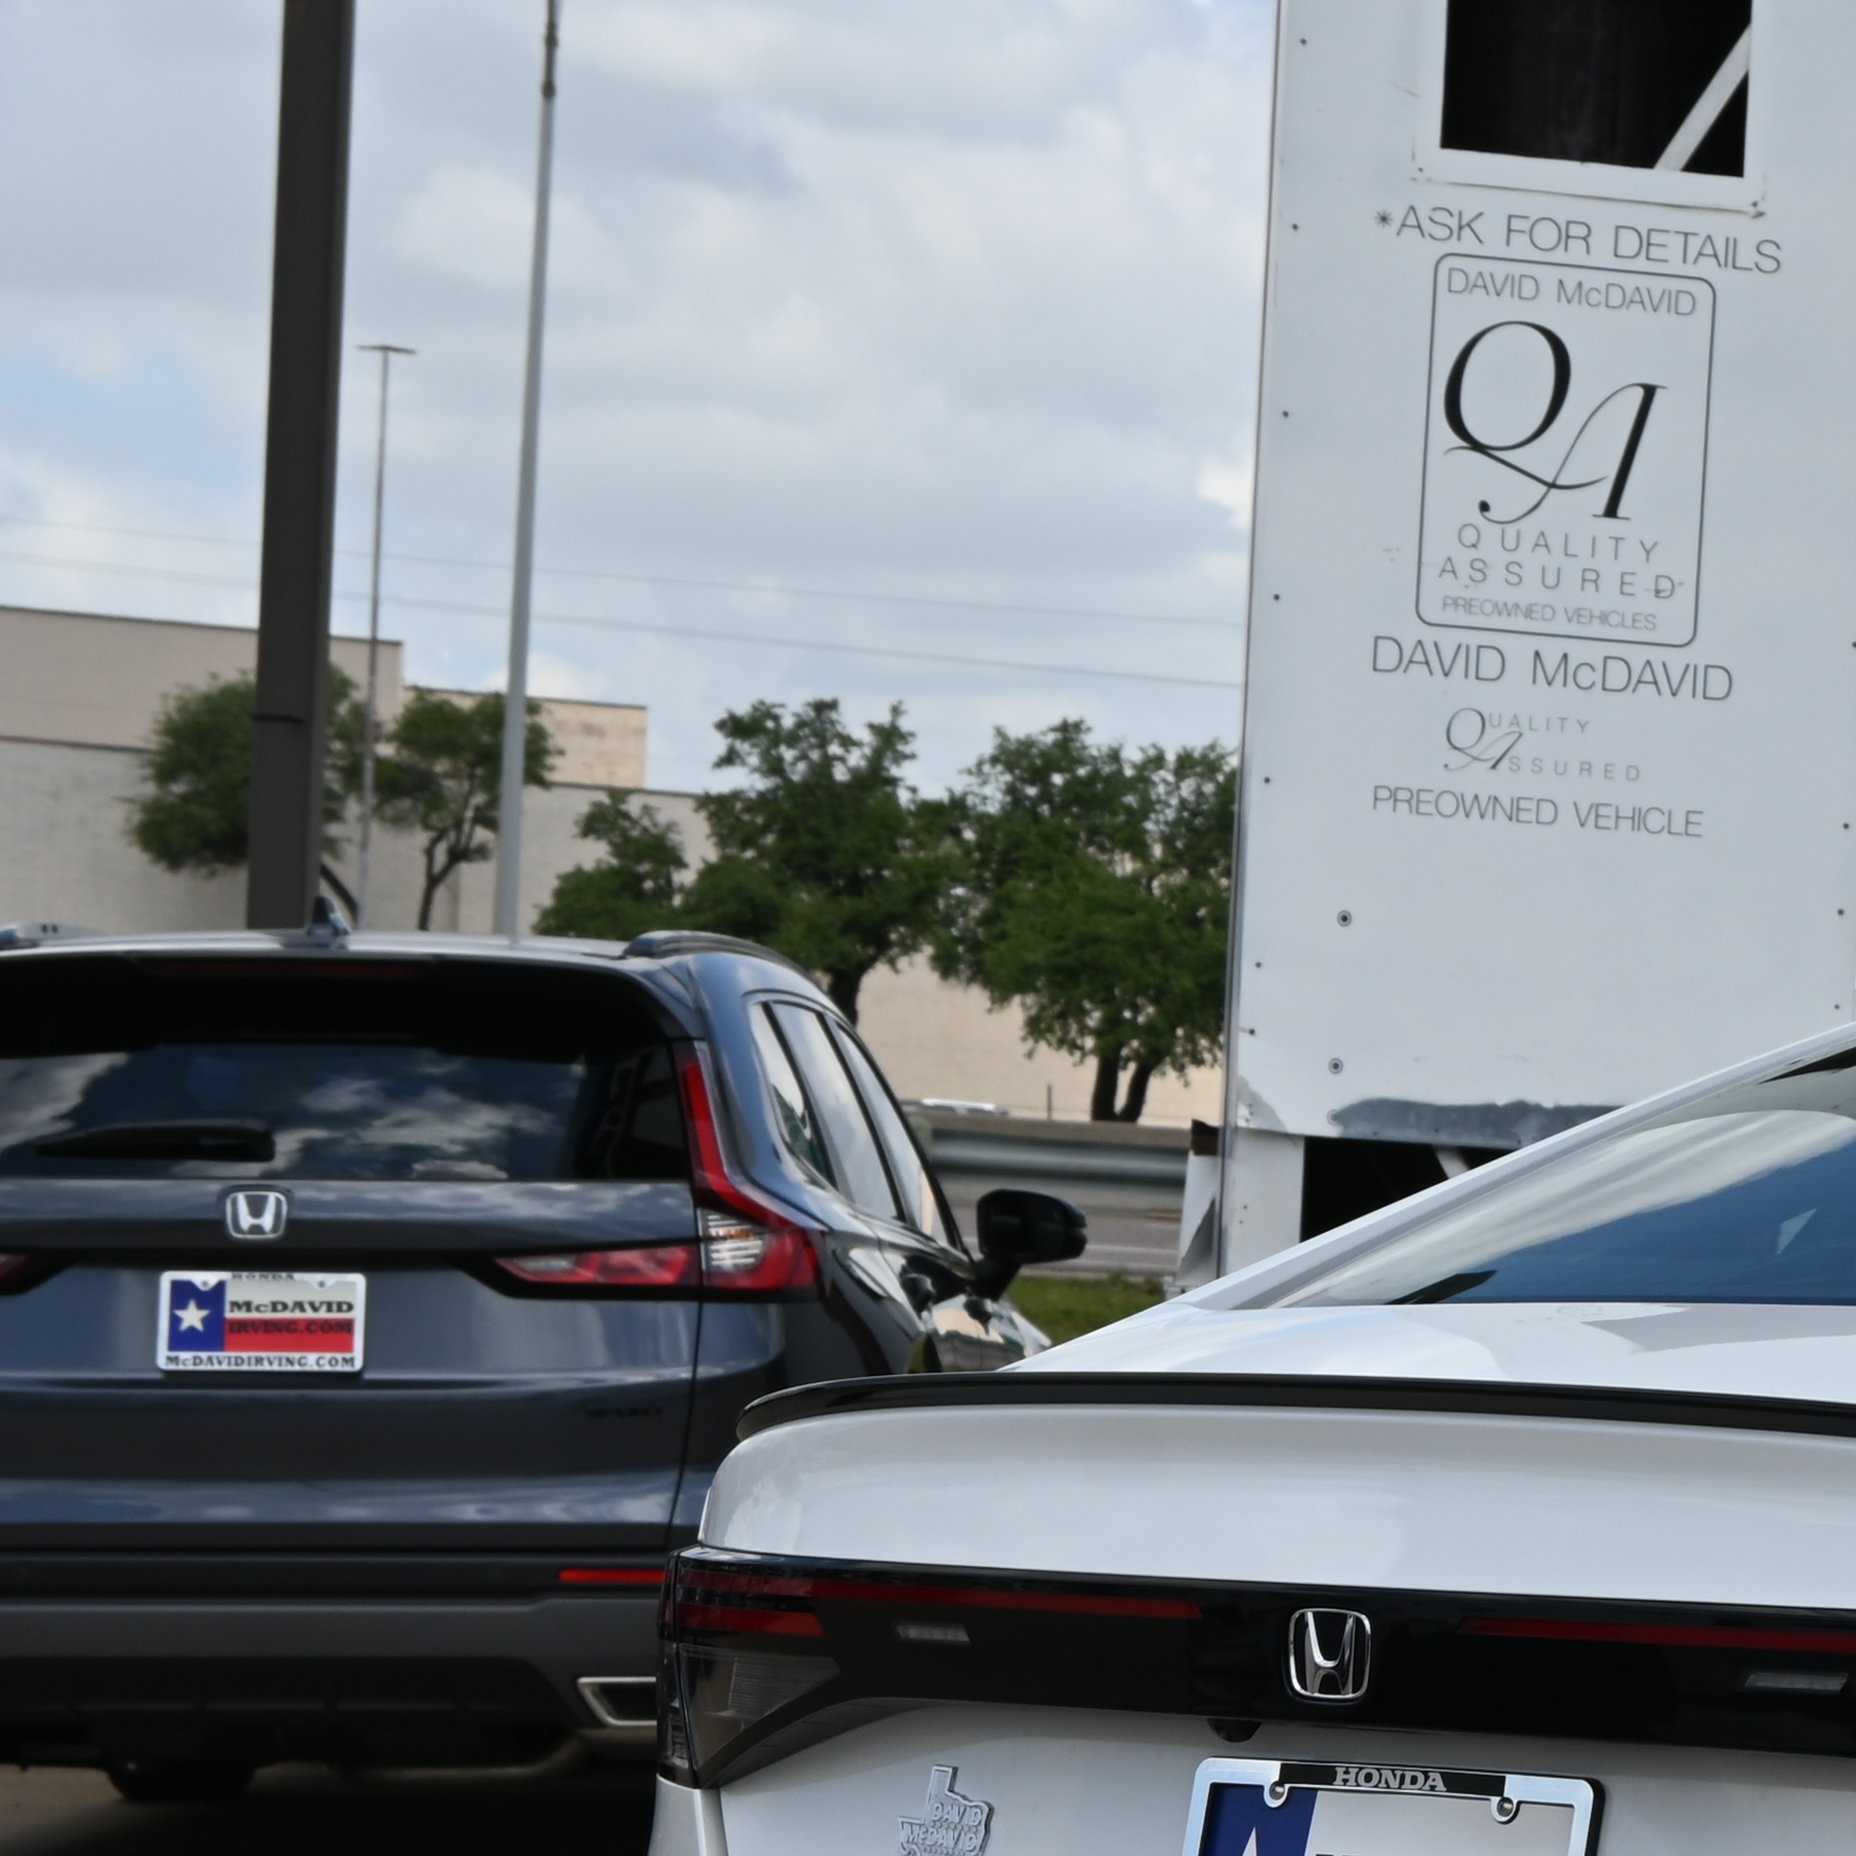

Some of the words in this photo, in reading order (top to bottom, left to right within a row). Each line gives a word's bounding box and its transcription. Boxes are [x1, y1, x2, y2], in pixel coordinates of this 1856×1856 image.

[1505, 214, 1592, 254] FOR
[1614, 226, 1782, 274] DETAILS
[1447, 268, 1540, 301] DAVID
[1557, 279, 1697, 316] McDAVID
[1457, 523, 1658, 563] QUALITY
[1439, 556, 1676, 599] ASSURED
[1442, 595, 1556, 622] PREOWNED
[1564, 606, 1658, 631] VEHICLES
[1372, 635, 1506, 682] DAVID
[1532, 649, 1733, 701] McDAVID
[1373, 785, 1559, 826] PREOWNED
[1573, 801, 1704, 838] VEHICLE
[229, 1300, 355, 1314] McDAVID
[165, 1355, 355, 1369] McDAVIDIRVING.COM
[1332, 1766, 1447, 1792] HONDA
